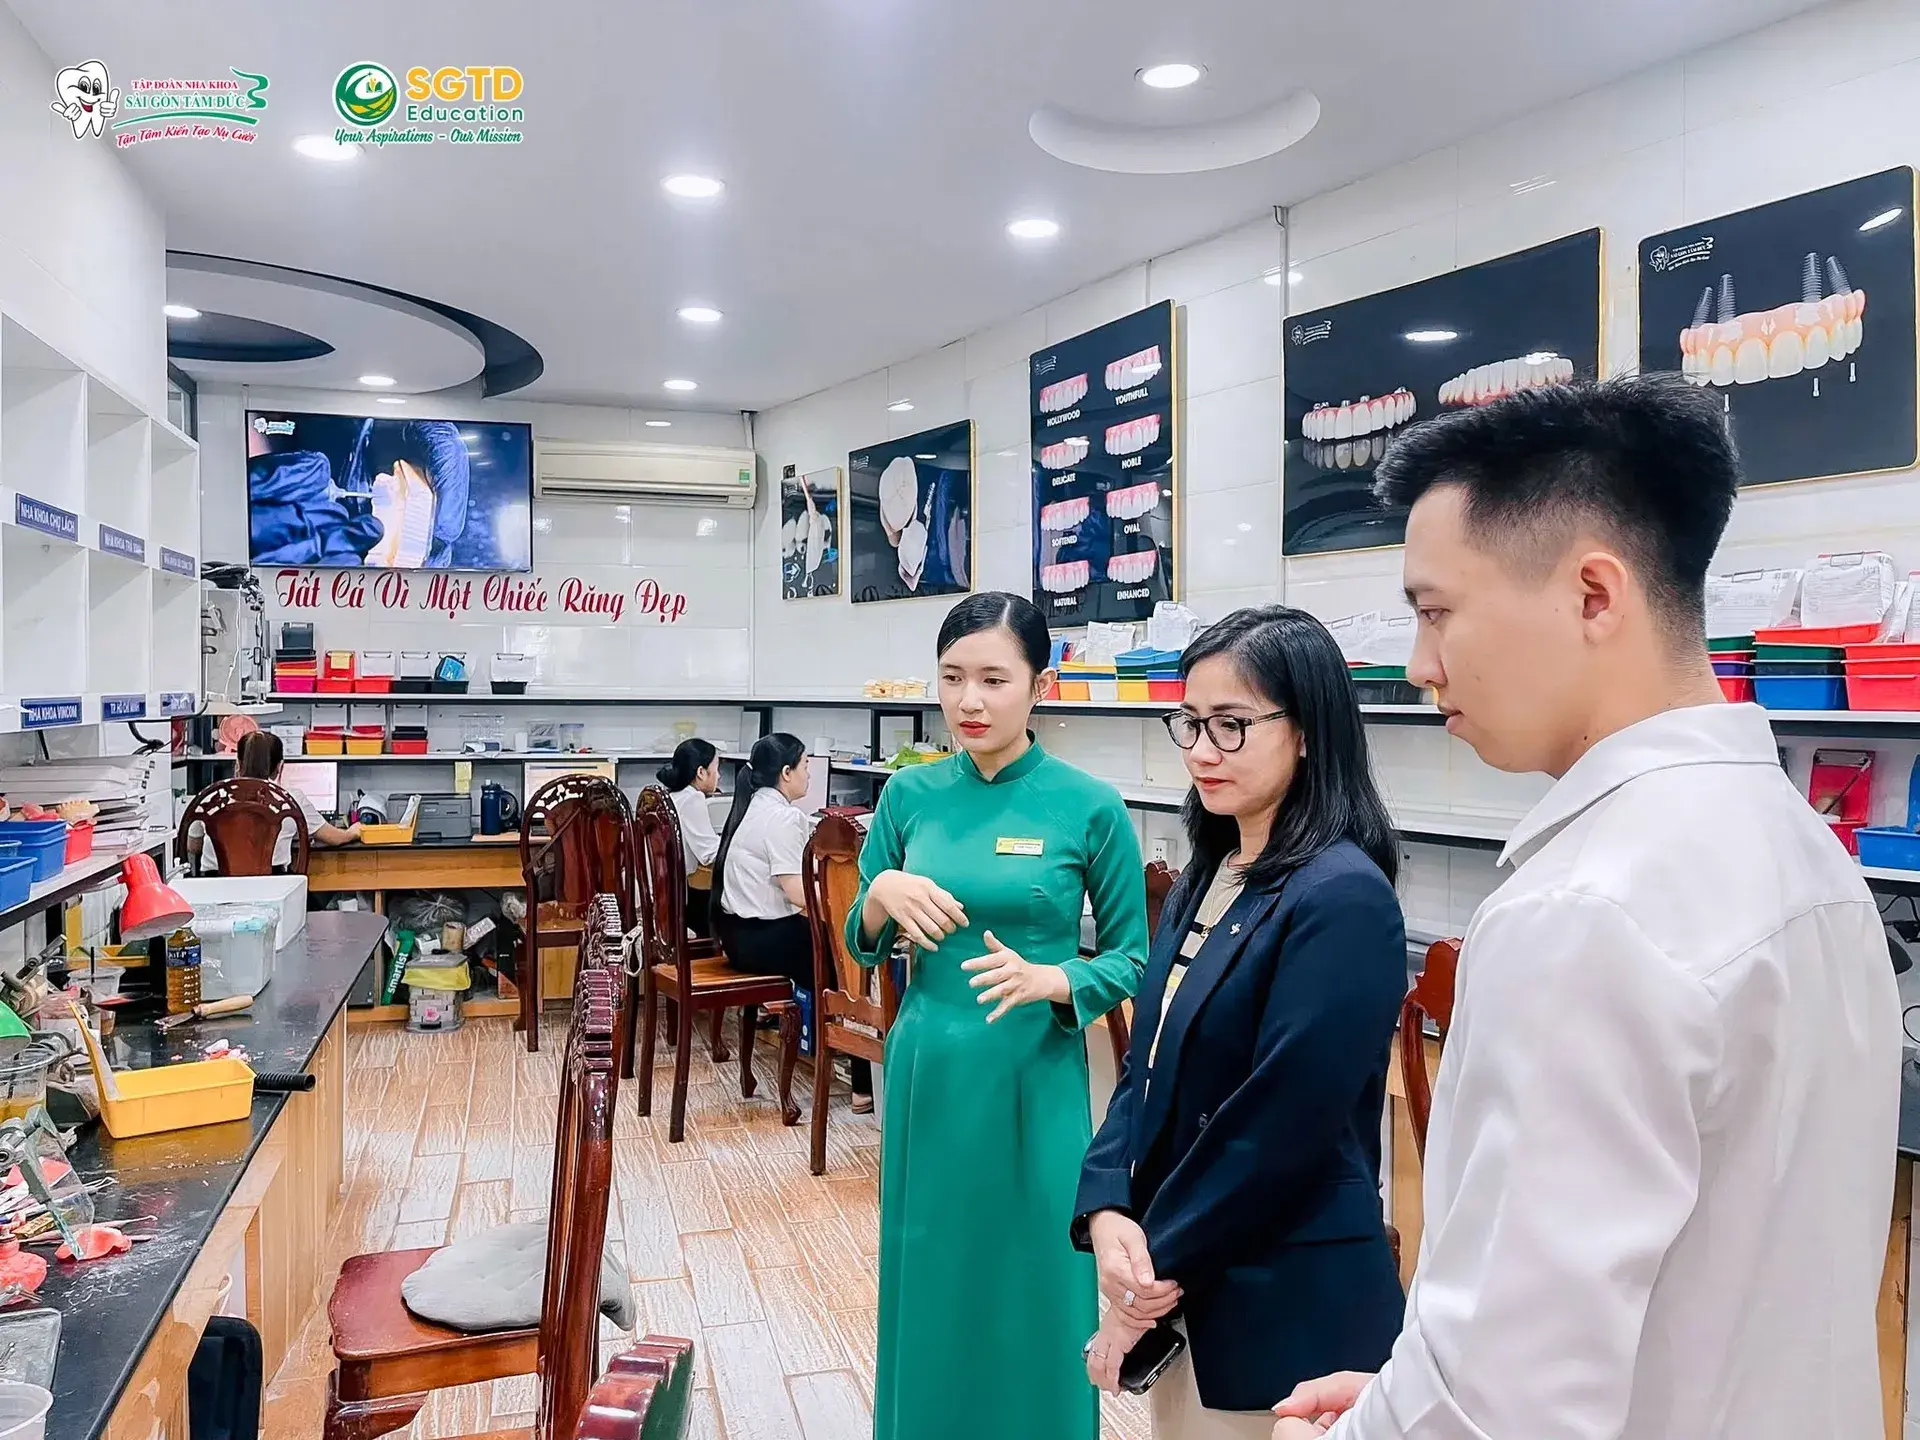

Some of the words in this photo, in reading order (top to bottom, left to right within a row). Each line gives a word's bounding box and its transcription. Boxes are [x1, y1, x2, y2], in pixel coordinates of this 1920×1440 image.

[1115, 387, 1149, 406] YOUTHFULL
[1046, 409, 1081, 427] HOLLYWOOD
[1121, 456, 1142, 469] NOBLE
[1052, 473, 1076, 487] DELICATE
[1123, 523, 1141, 534] OVAL
[1051, 535, 1078, 548] SOFTENED
[275, 569, 322, 609] Tất
[331, 570, 366, 609] Cả
[373, 570, 410, 610] Vì
[419, 573, 472, 620] Một
[483, 574, 549, 612] Chiếc
[558, 577, 628, 622] Răng
[634, 578, 689, 623] Đẹp
[1116, 588, 1150, 601] ENHANCED
[1053, 596, 1077, 607] NATURAL
